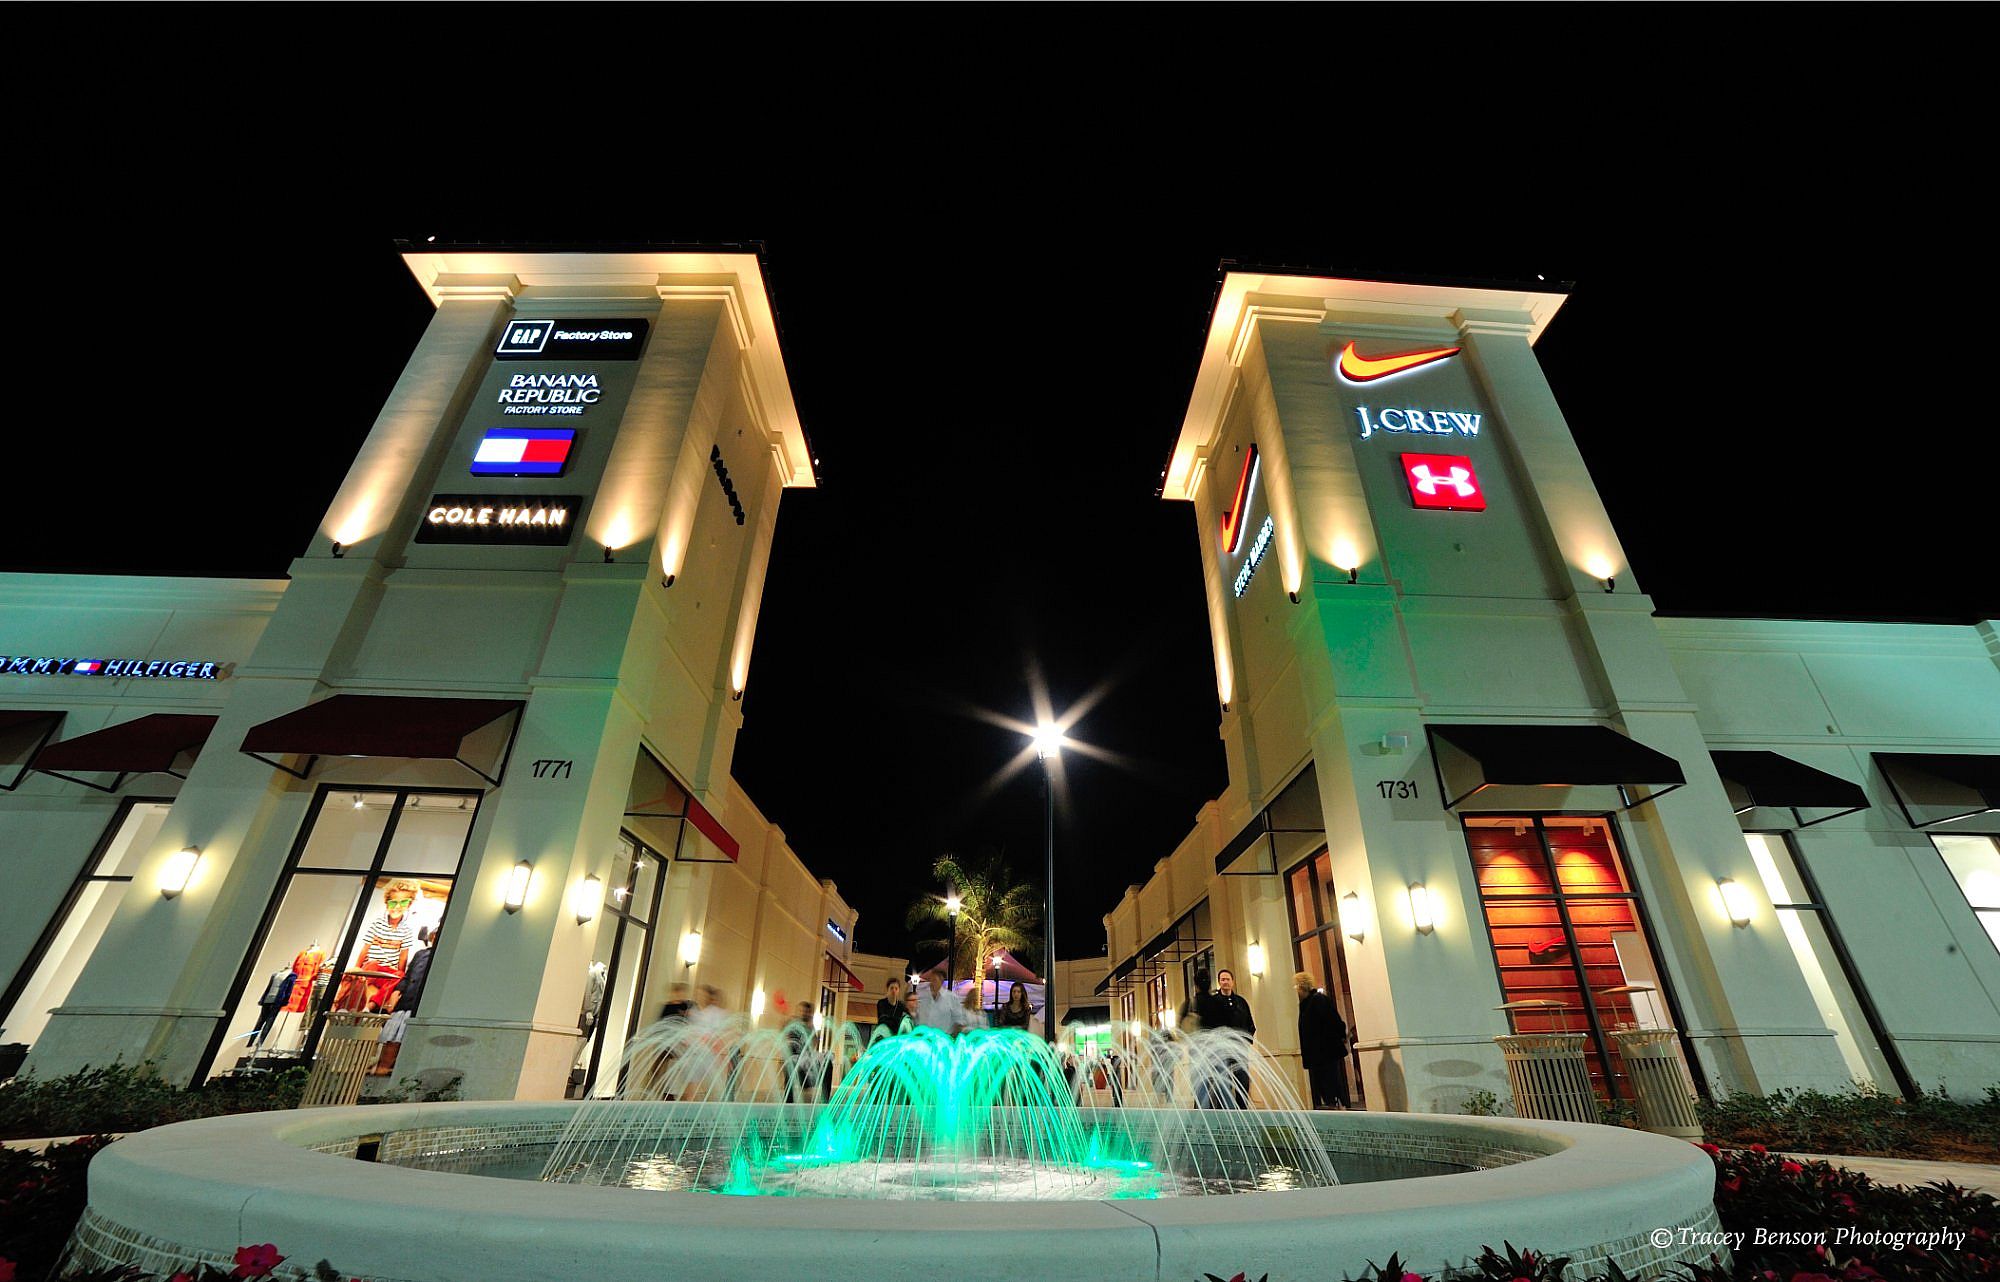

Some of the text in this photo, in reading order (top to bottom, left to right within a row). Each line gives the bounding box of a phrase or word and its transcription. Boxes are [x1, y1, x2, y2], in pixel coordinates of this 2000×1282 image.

[510, 328, 542, 345] GAP
[554, 330, 633, 342] Factory Store
[509, 374, 598, 388] BANANA
[497, 388, 601, 404] REPUBLIC
[503, 405, 584, 415] FACTORY STORE
[1355, 406, 1482, 439] J.CREW
[428, 506, 567, 526] COLE HAAN
[103, 659, 215, 678] HILFIGER
[531, 759, 573, 779] 1771
[1376, 780, 1419, 799] 1731
